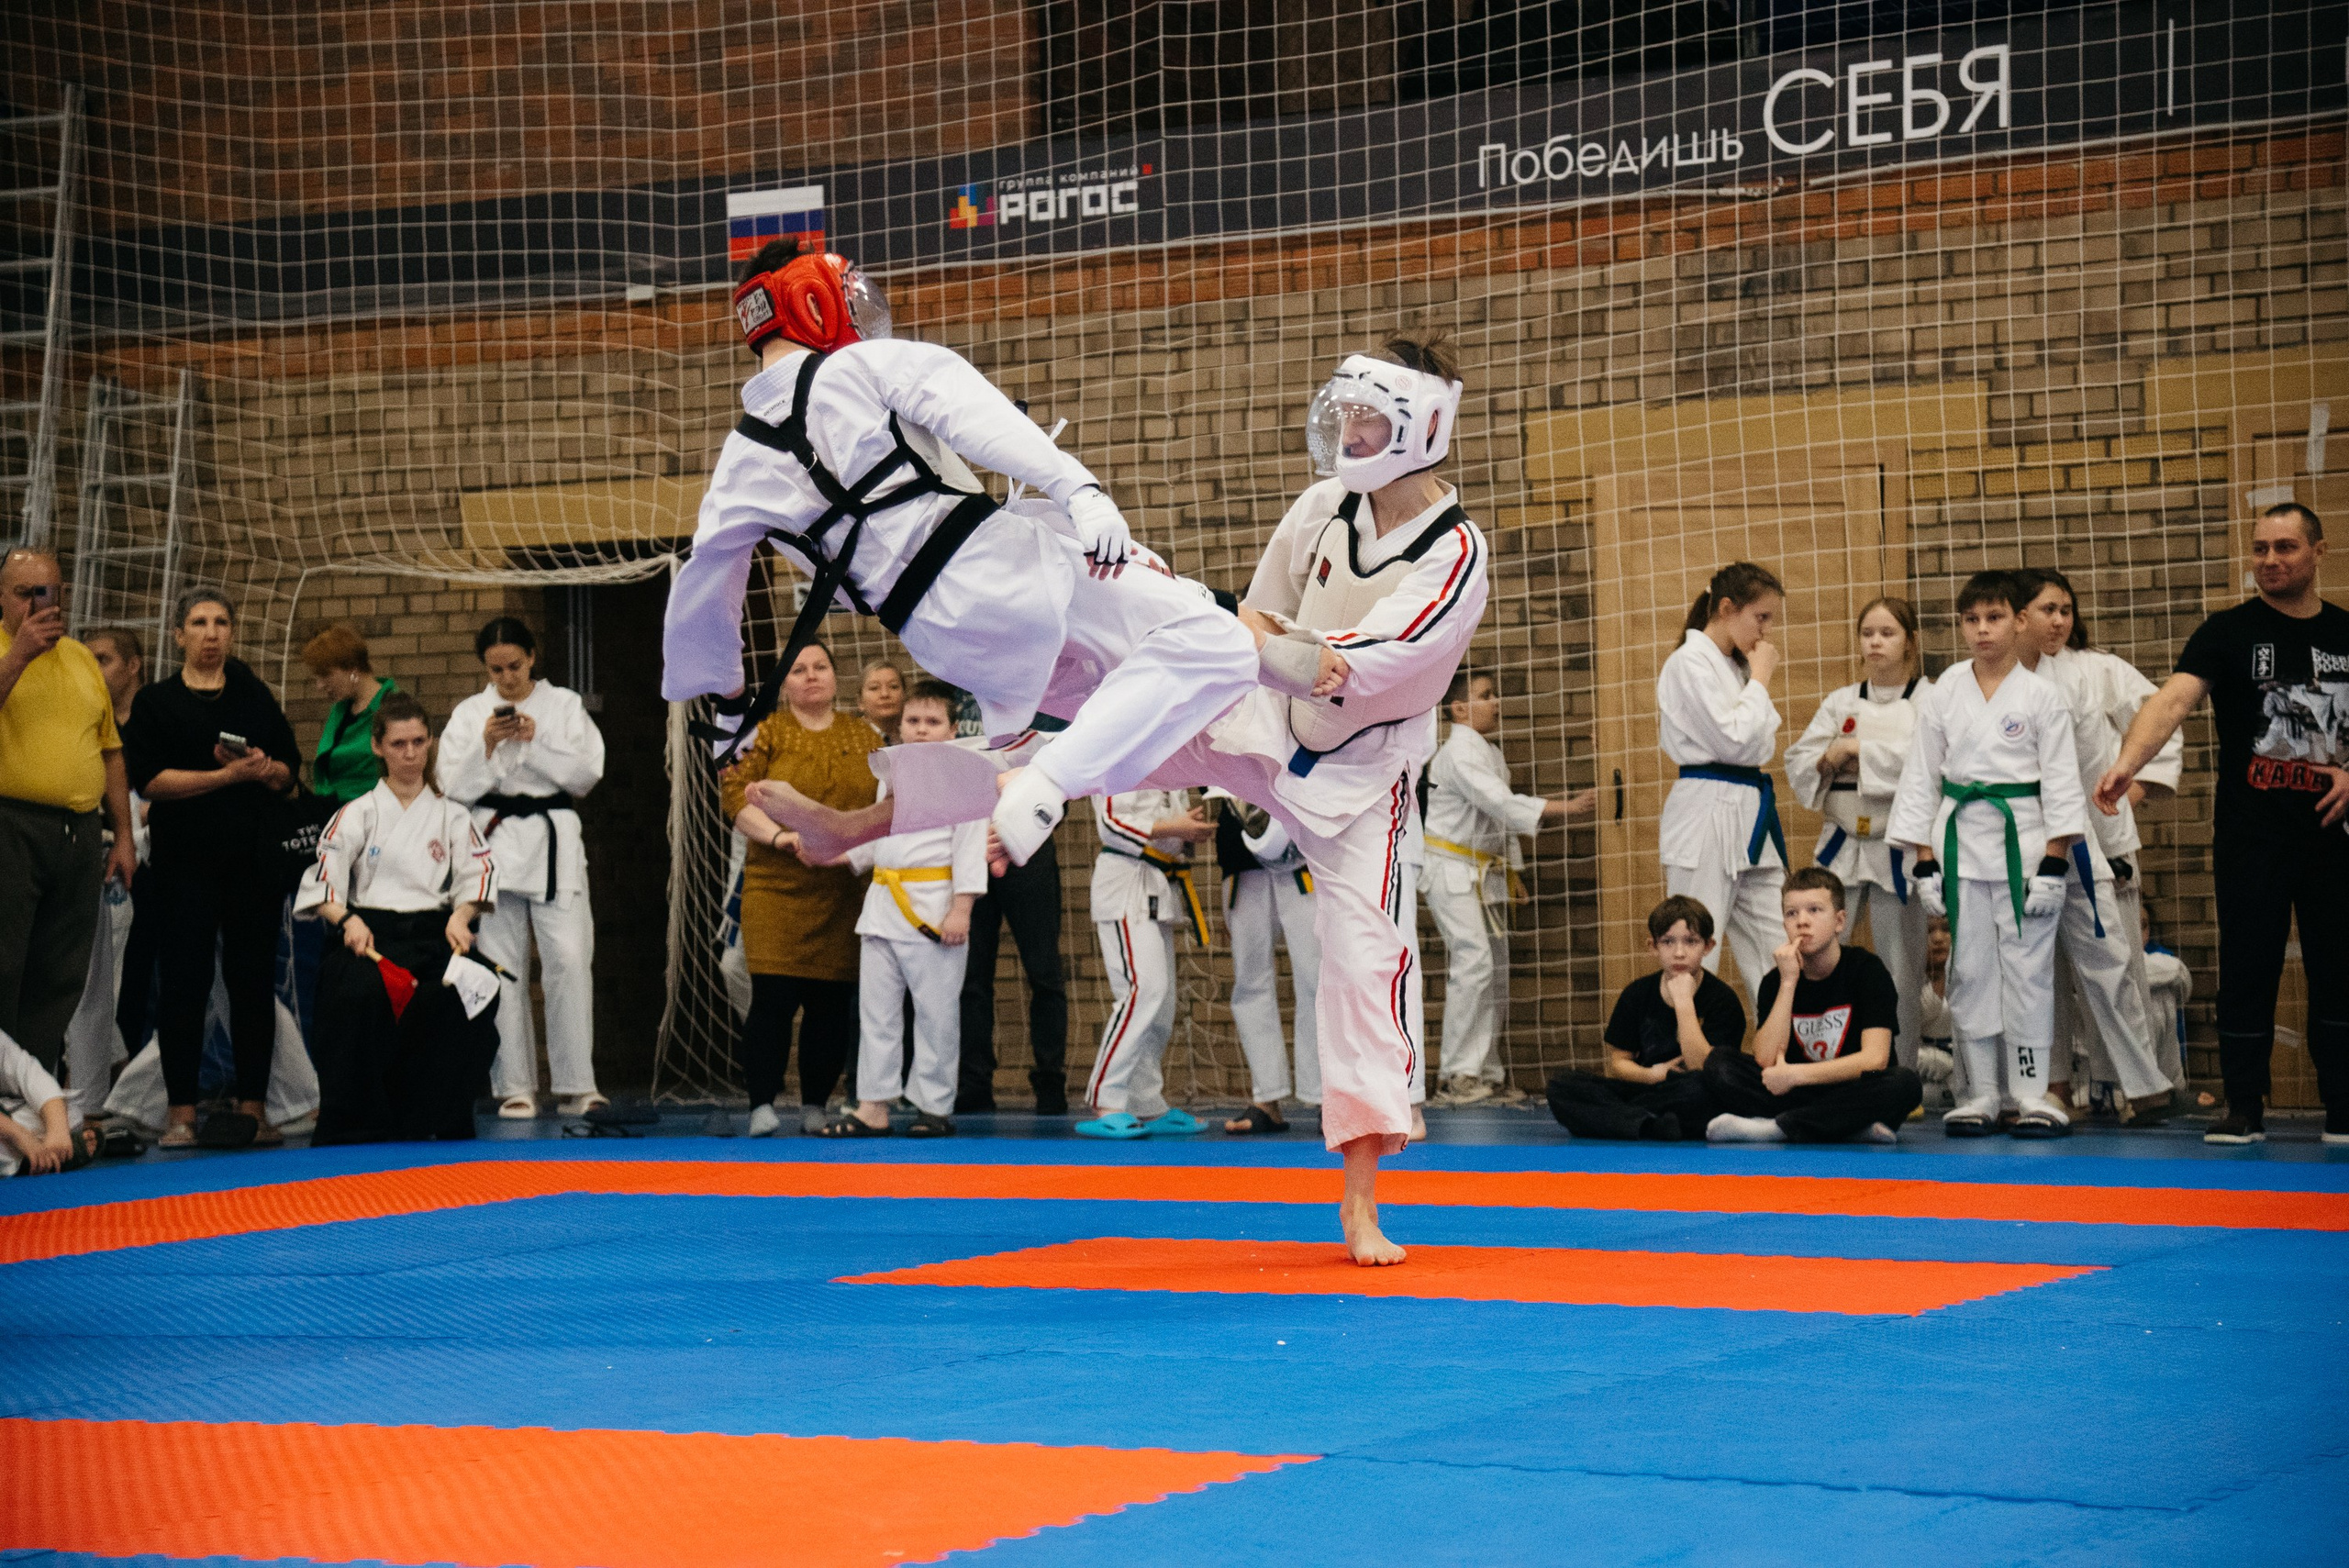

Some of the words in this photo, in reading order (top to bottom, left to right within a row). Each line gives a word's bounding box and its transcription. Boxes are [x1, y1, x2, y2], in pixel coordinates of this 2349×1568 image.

[1478, 128, 1744, 188] Победишь
[1763, 43, 2009, 154] СЕБЯ
[1058, 164, 1139, 183] компаний
